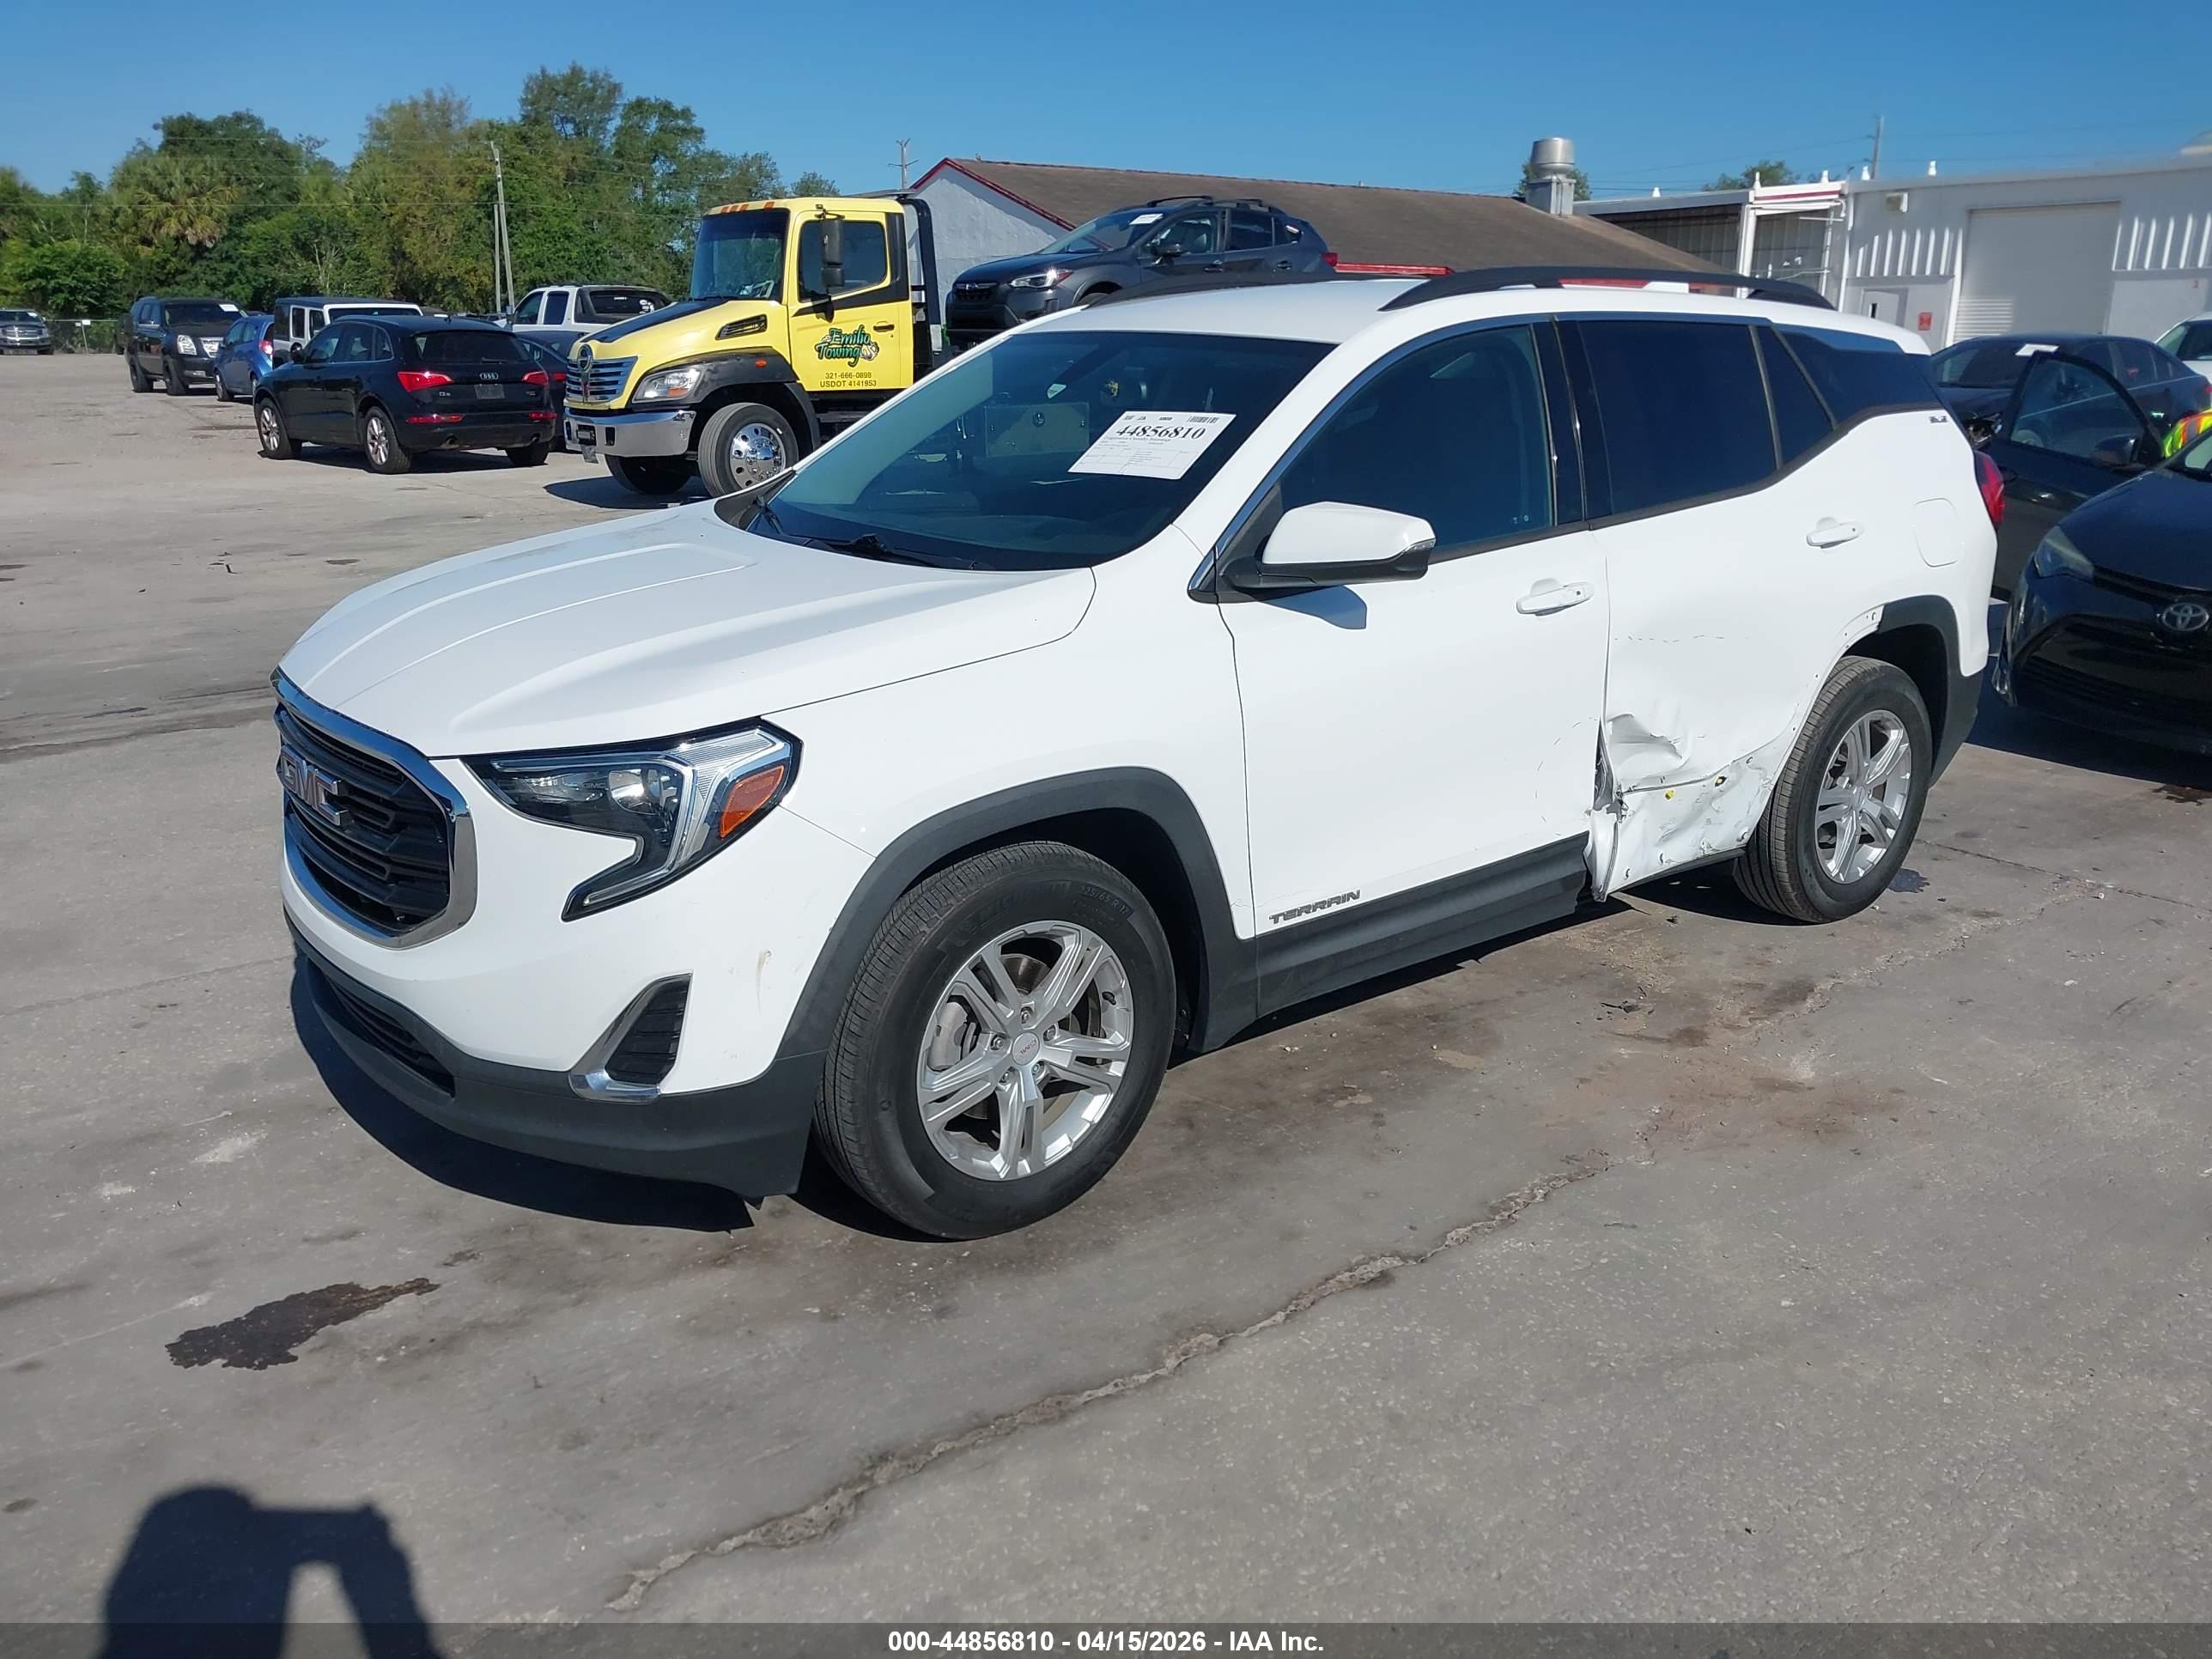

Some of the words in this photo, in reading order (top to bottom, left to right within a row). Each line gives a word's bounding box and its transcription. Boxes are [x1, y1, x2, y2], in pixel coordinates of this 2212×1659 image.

[829, 325, 871, 344] Emilio
[815, 343, 860, 368] Towing
[1116, 424, 1206, 440] 44856810
[280, 744, 341, 826] GMC
[1269, 889, 1360, 925] TERRAIN
